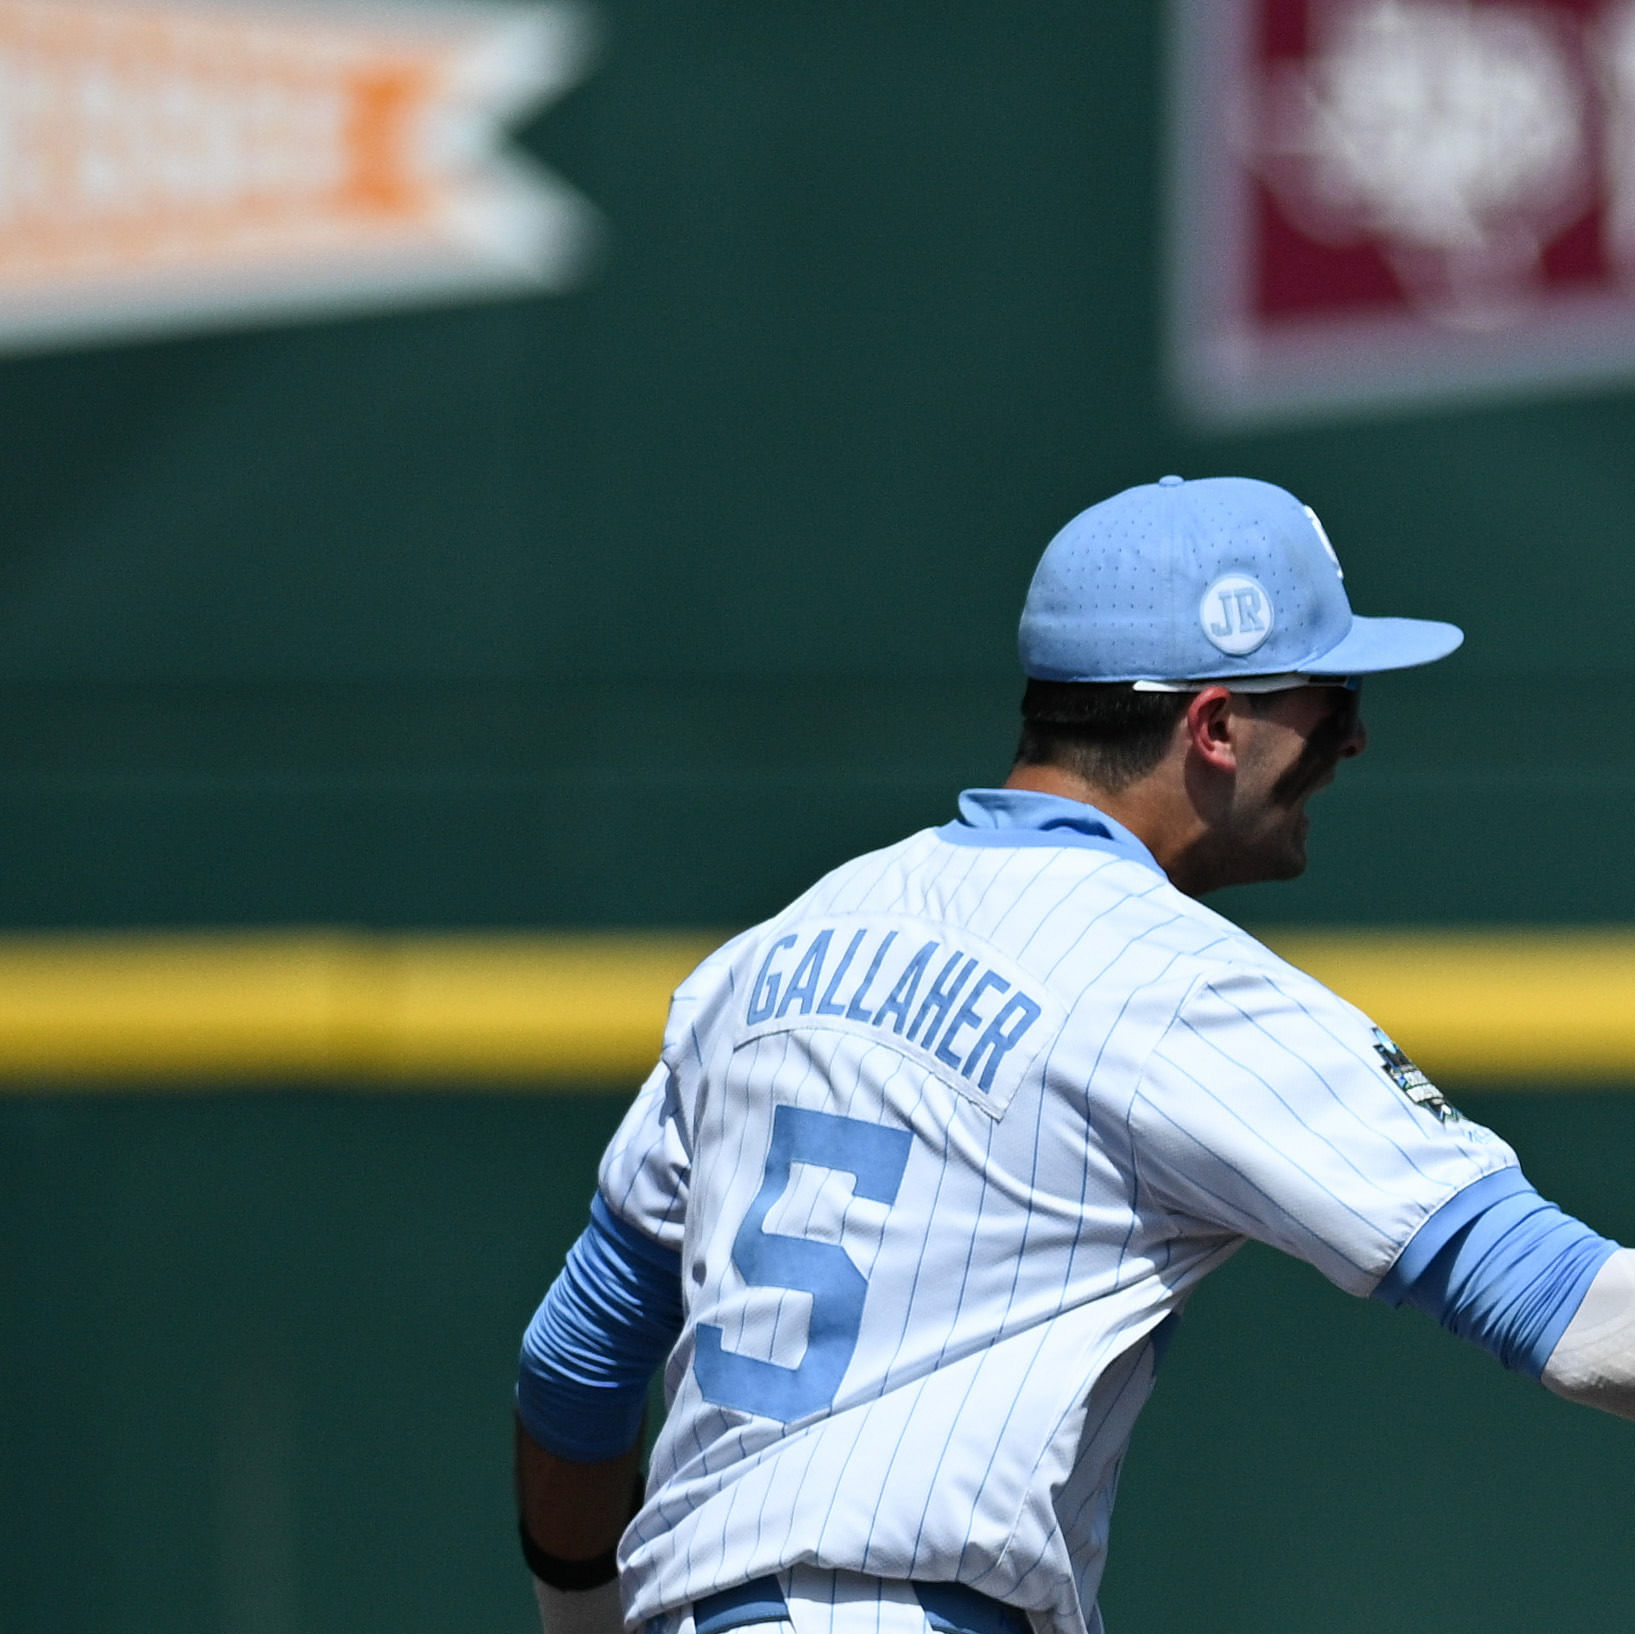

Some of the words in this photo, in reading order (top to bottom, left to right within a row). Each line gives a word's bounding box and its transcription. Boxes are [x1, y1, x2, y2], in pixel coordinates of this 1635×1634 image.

[1210, 587, 1265, 637] JR
[746, 929, 1041, 1094] GALLAHER
[693, 1105, 914, 1423] 5
